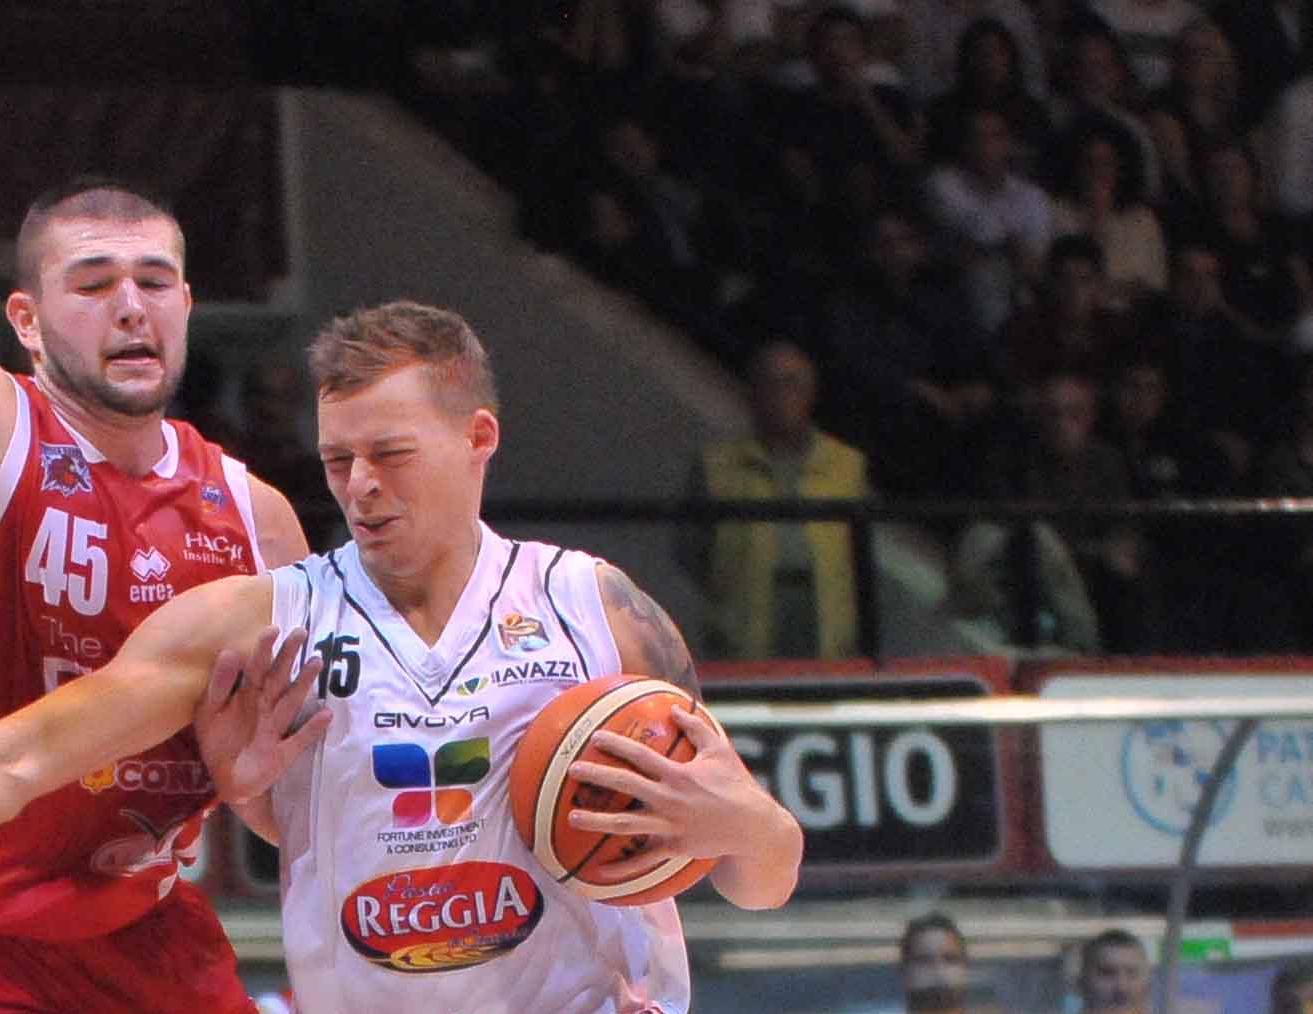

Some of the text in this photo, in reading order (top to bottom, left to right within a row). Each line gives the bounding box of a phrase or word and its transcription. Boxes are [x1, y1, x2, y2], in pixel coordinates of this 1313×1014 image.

[25, 506, 108, 616] 45
[40, 614, 103, 658] The
[314, 631, 362, 700] 15
[373, 705, 491, 729] GIVOVA
[377, 831, 424, 842] FORTUNE
[356, 875, 529, 937] REGGIA
